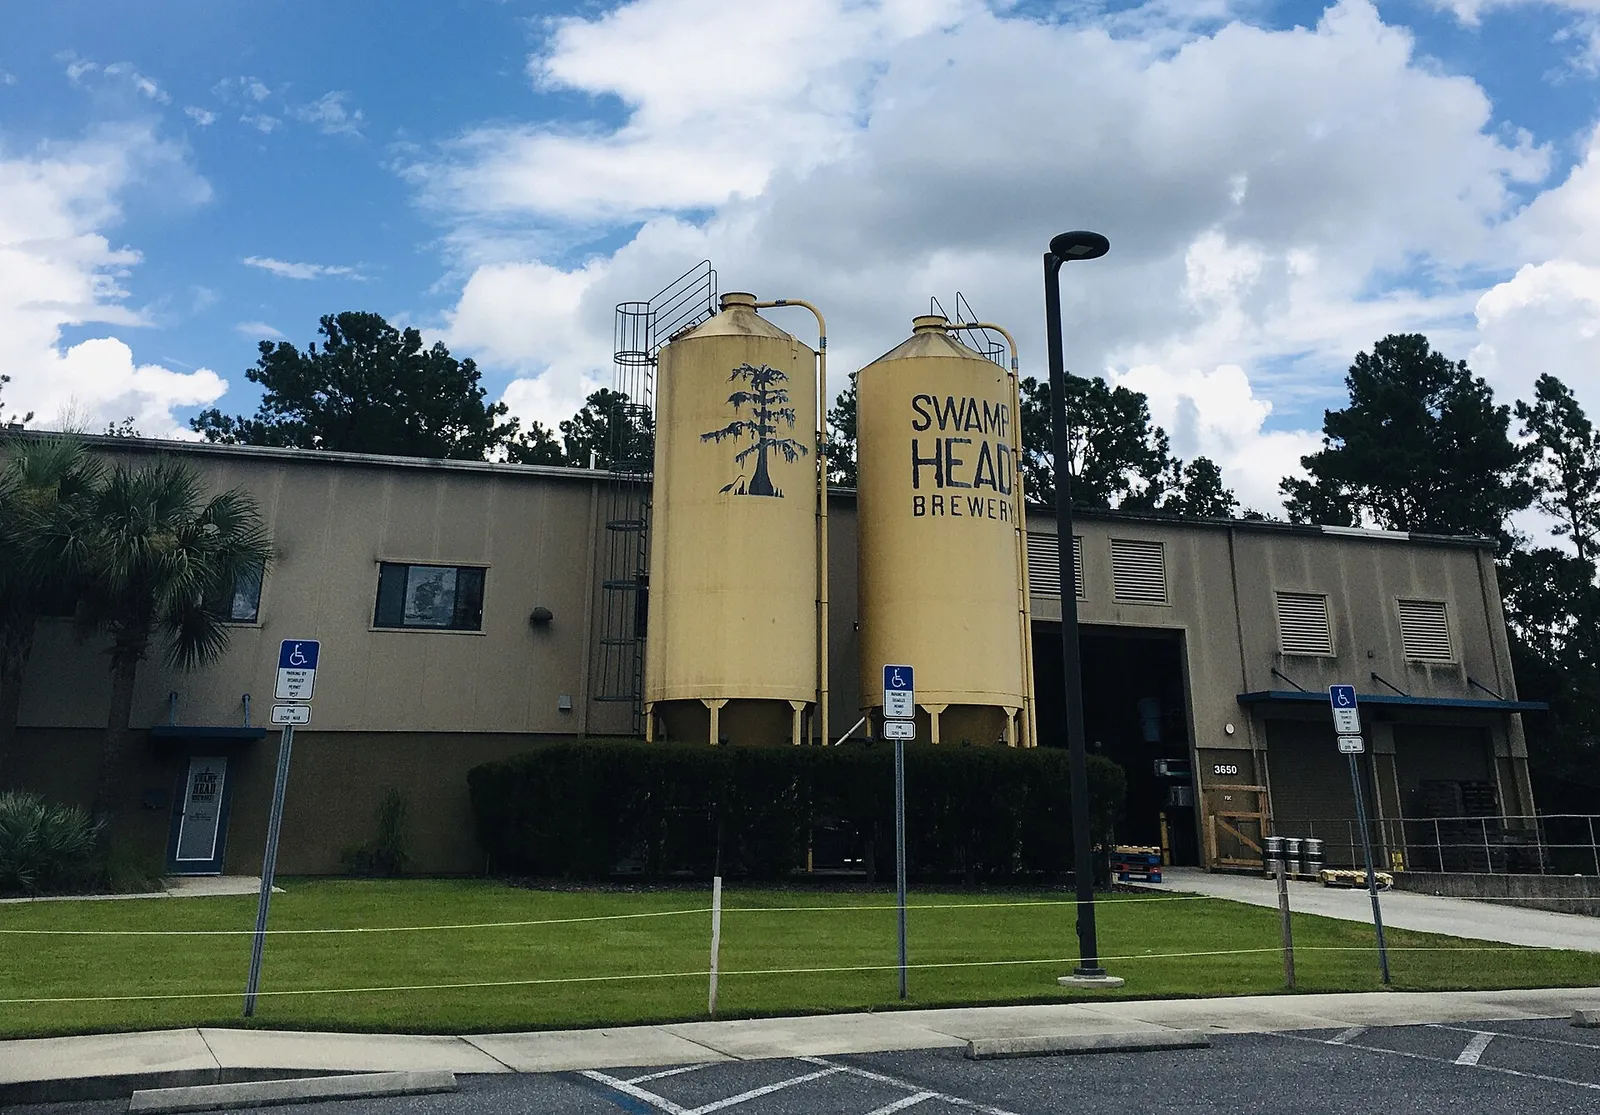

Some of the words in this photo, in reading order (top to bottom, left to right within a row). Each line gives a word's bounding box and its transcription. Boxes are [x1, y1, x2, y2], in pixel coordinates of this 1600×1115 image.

[911, 394, 1010, 438] SWAMP
[911, 438, 1012, 496] HEAD
[913, 495, 1015, 524] BREWERY
[1214, 765, 1237, 774] 3650
[192, 783, 216, 794] HEAD
